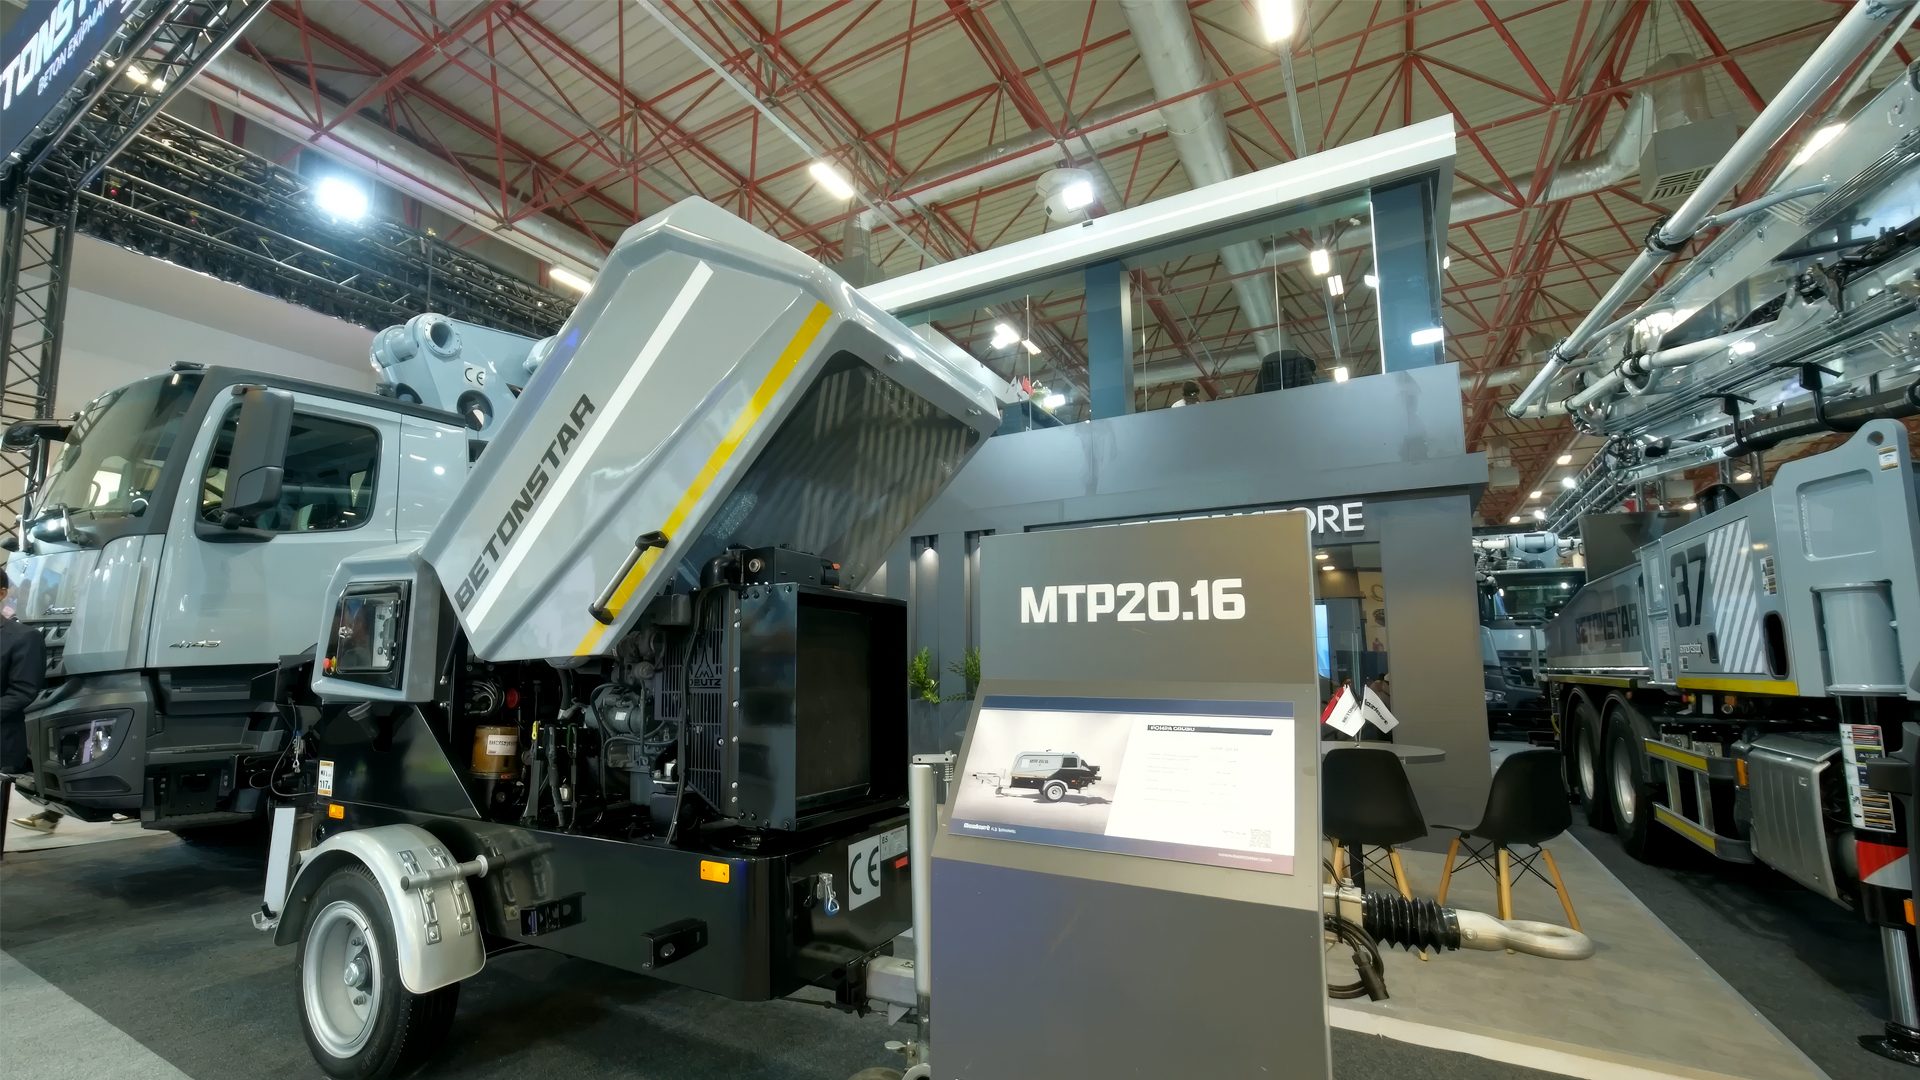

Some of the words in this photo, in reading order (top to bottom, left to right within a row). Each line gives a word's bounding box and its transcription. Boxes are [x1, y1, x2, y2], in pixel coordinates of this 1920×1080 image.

[0, 0, 87, 110] TONS
[464, 367, 485, 386] CE
[453, 393, 596, 612] BETONSTAR
[1020, 578, 1246, 624] MTP20.16
[1670, 542, 1707, 628] 37
[849, 845, 880, 895] CE
